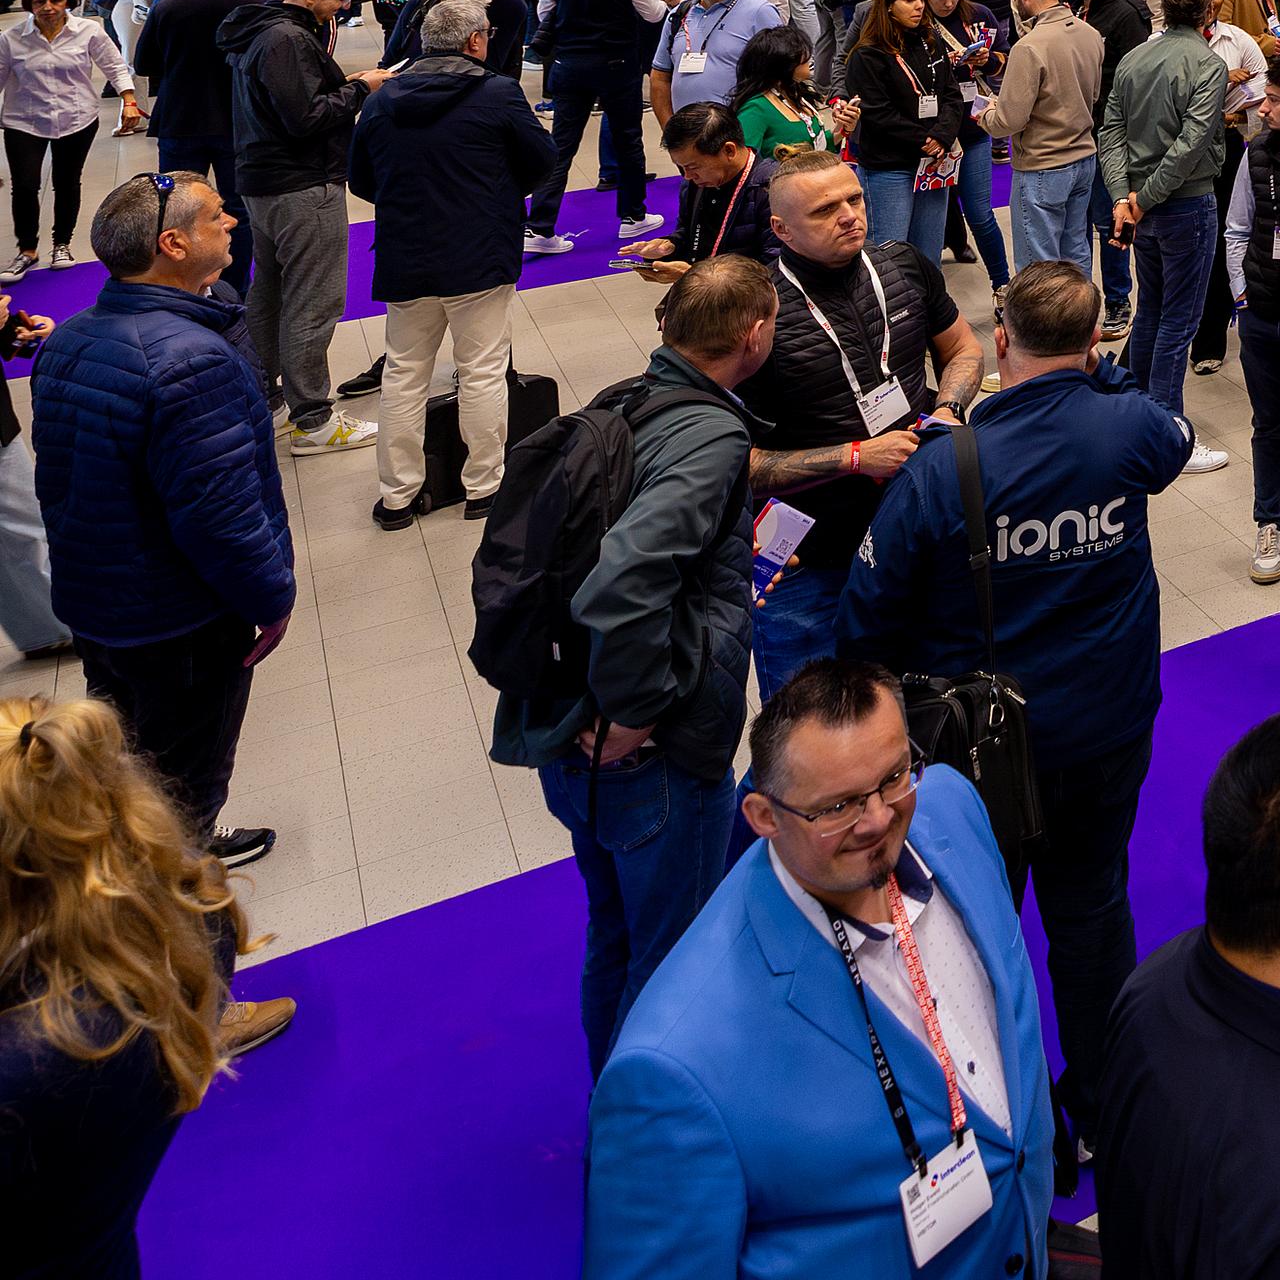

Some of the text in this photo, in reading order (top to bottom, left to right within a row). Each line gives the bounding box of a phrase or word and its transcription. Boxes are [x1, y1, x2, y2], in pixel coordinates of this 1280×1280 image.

[1048, 533, 1126, 562] SYSTEMS
[830, 919, 862, 986] NEXARO
[867, 1023, 895, 1091] NEXARO
